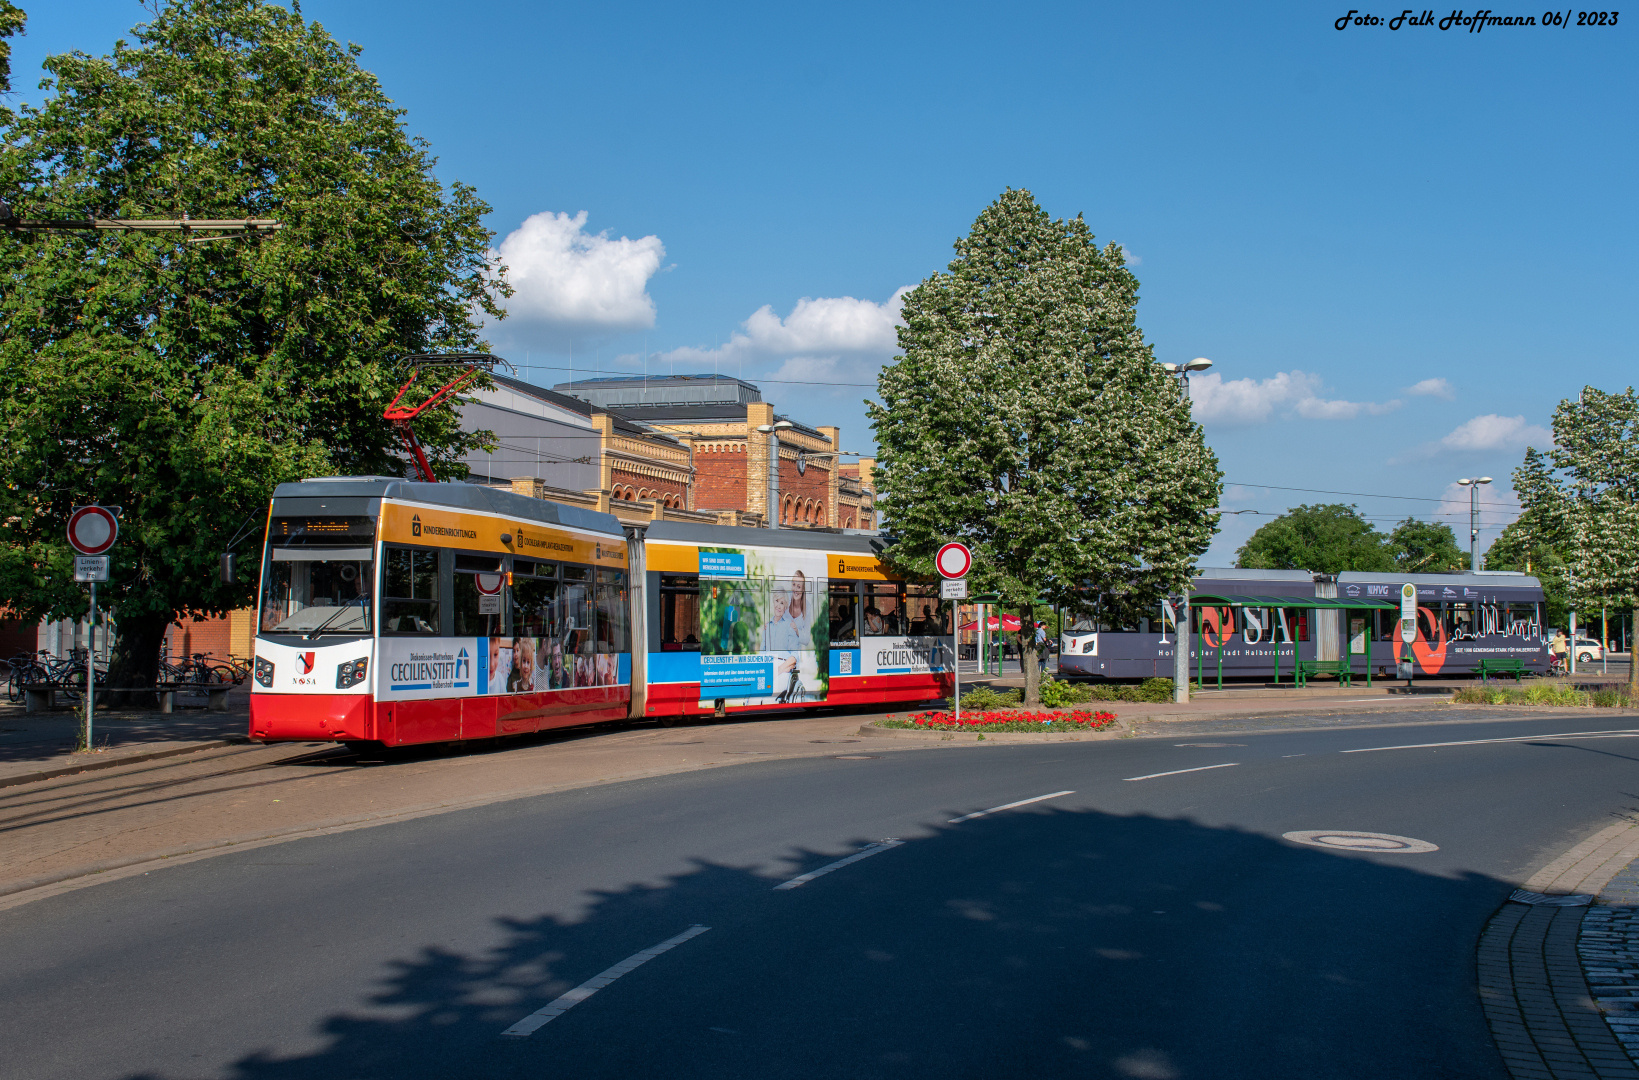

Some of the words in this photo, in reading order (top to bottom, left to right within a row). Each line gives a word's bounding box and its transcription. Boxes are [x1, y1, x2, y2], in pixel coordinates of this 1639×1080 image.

[423, 525, 477, 539] KINDEREINRICHTUNGEN
[703, 656, 734, 664] CECILIENSTIFT
[876, 650, 931, 666] CECILIENSTIFT
[391, 662, 455, 682] CECILIENSTIFT
[432, 680, 454, 689] Halberstadt
[388, 710, 392, 723] 1
